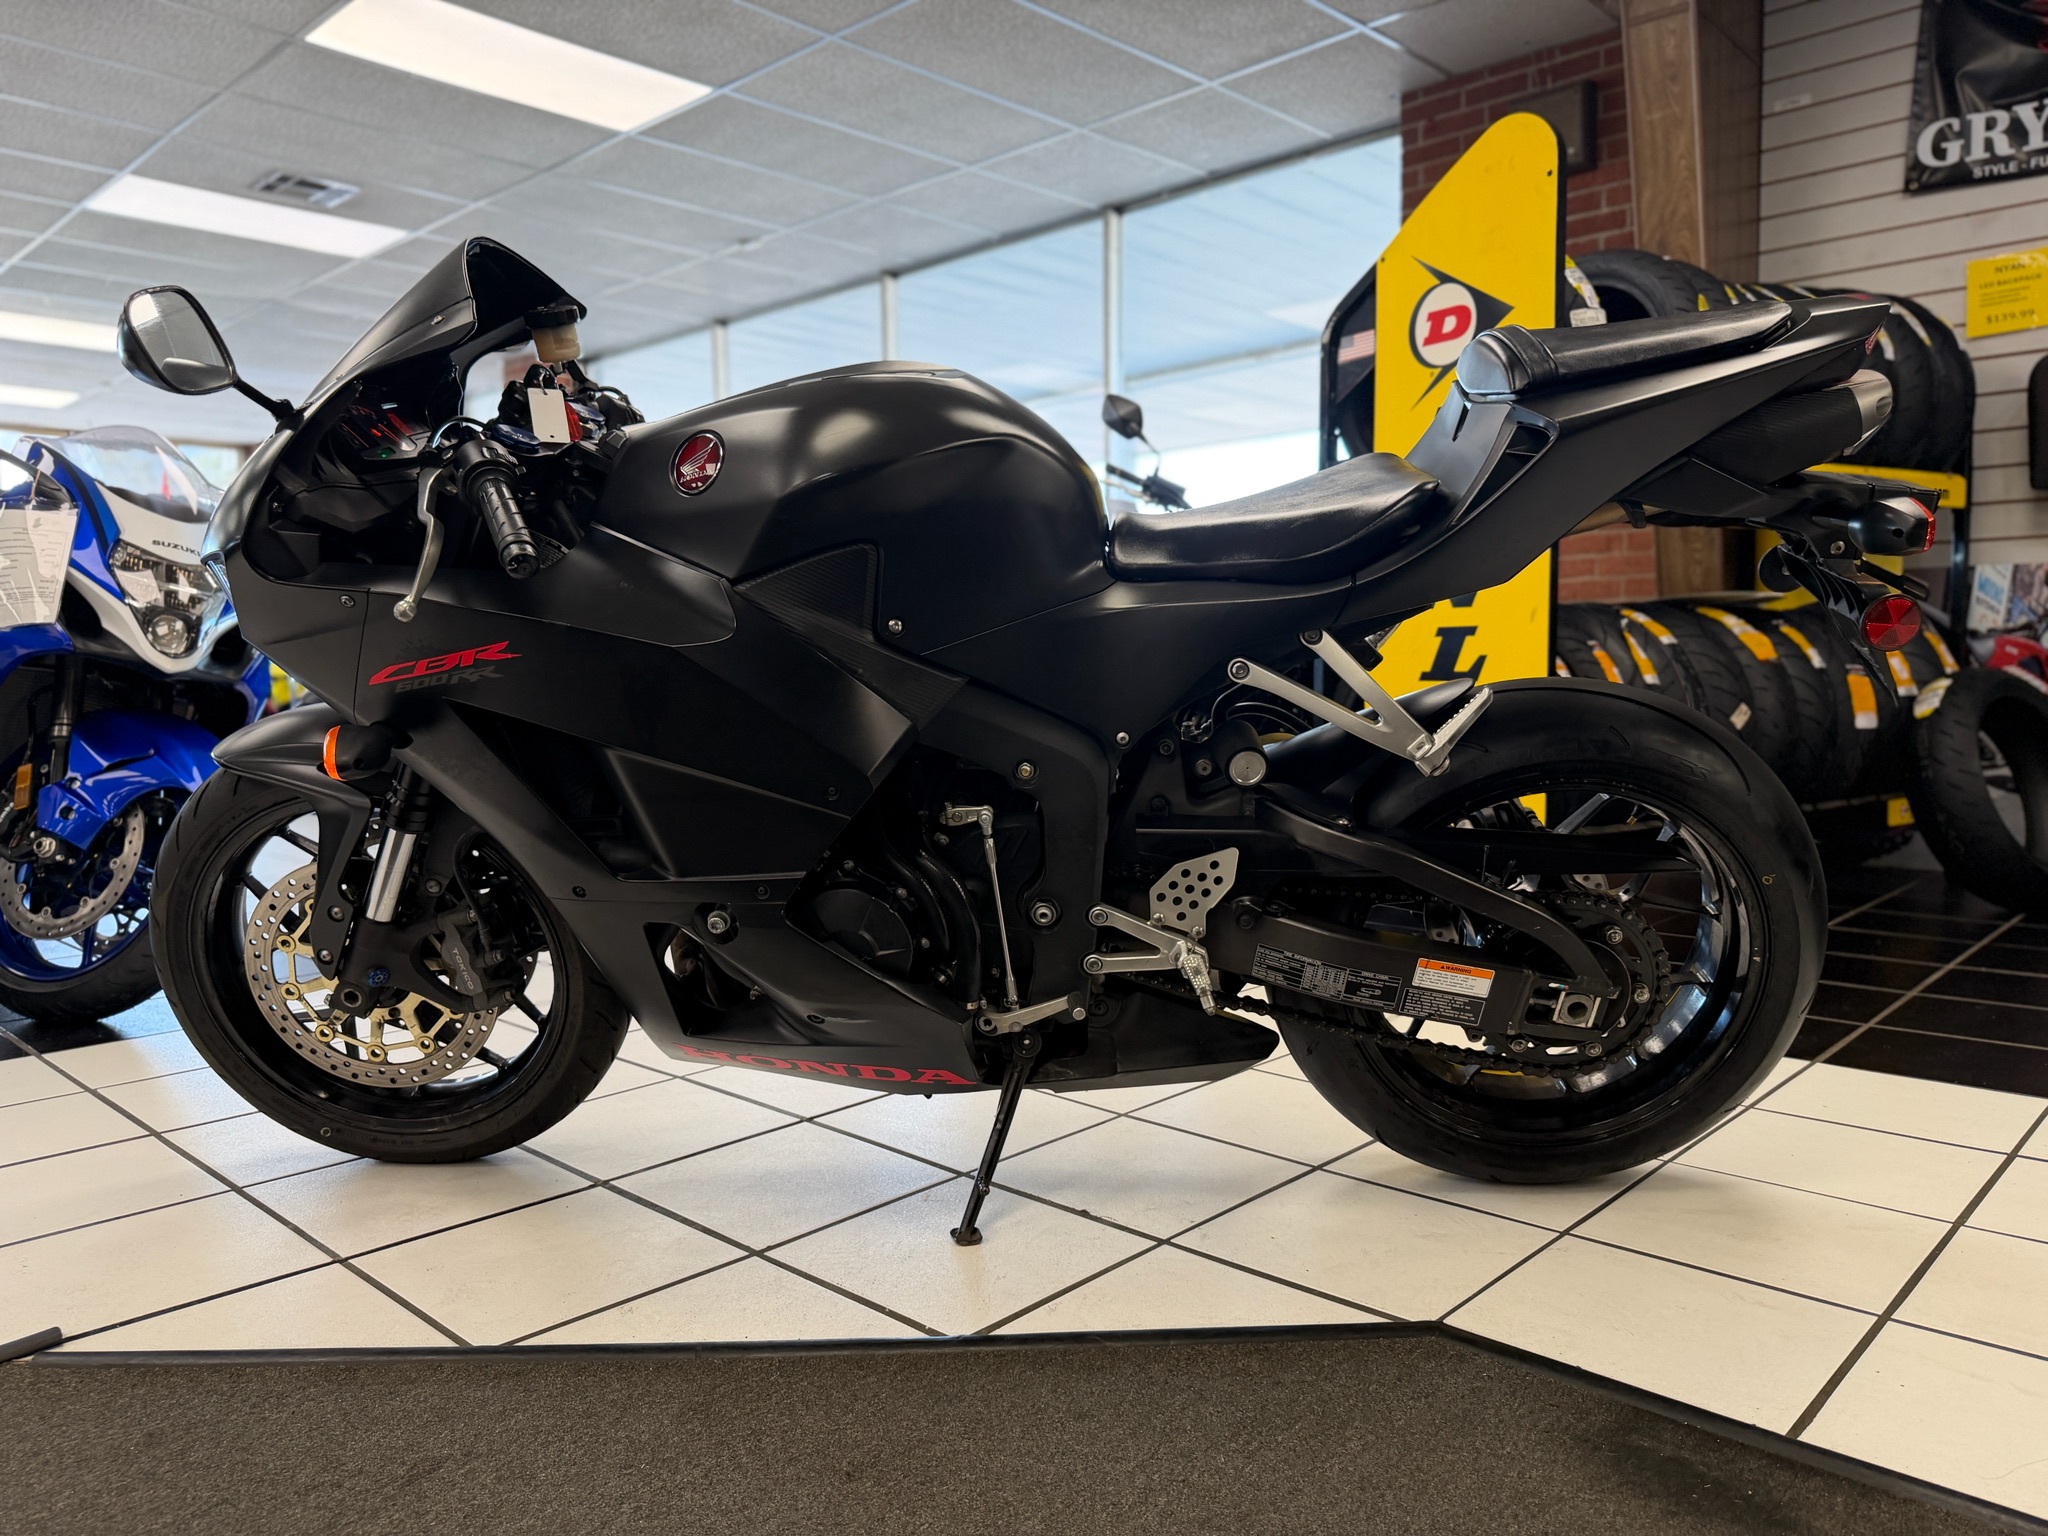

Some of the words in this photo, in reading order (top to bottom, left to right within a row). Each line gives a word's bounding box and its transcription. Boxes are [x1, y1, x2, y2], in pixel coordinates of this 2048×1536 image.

[1972, 160, 2019, 179] STYLE
[1421, 303, 1473, 348] D
[369, 641, 522, 685] CBR
[452, 947, 475, 990] TOKICO
[1446, 965, 1472, 975] WARNING
[673, 1043, 977, 1085] HONDA
